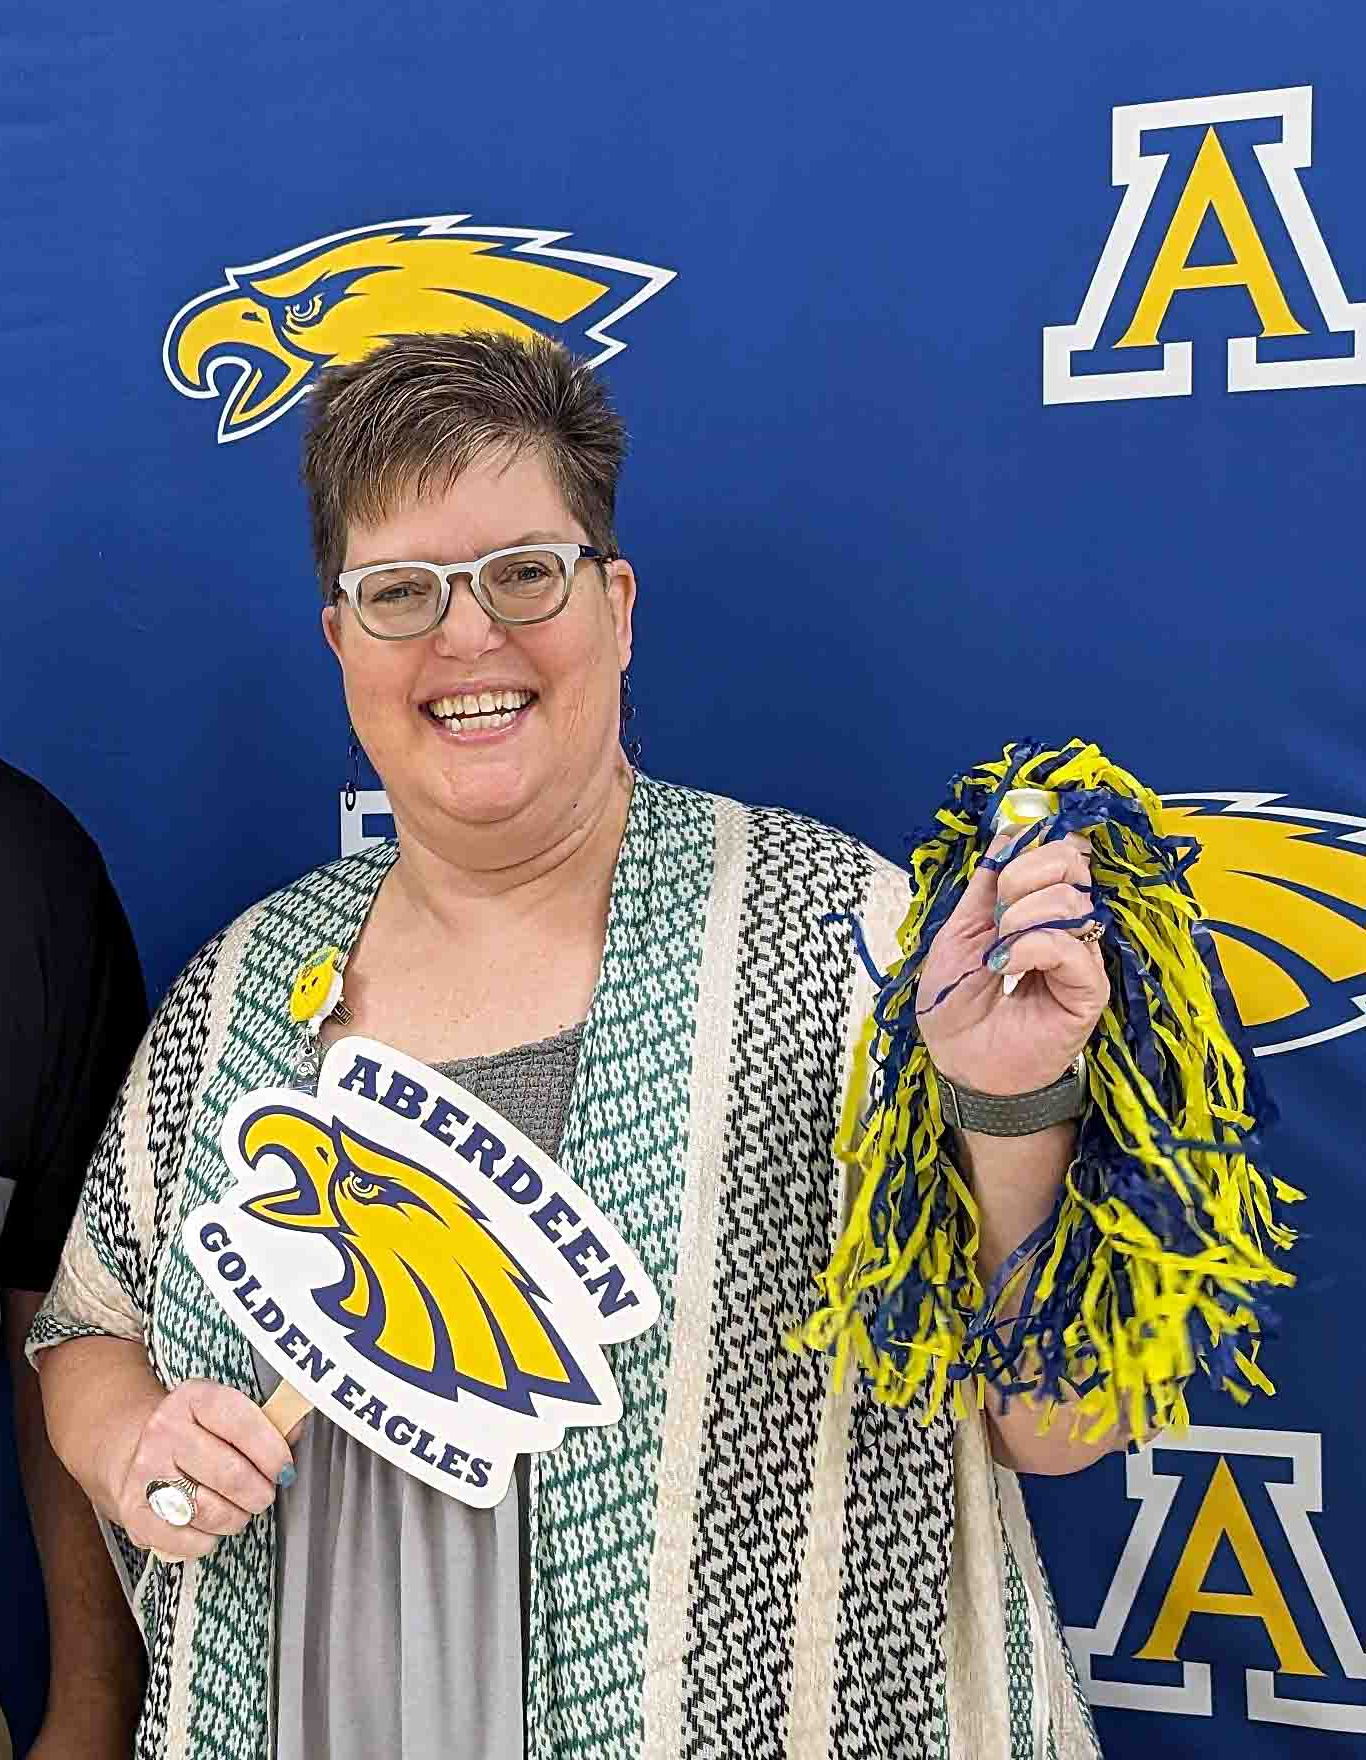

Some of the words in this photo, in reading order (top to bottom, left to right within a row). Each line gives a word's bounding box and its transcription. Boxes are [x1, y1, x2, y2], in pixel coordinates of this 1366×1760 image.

[1043, 85, 1366, 405] A
[338, 1054, 640, 1319] ABERDEEN
[199, 1222, 337, 1383] GOLDEN
[330, 1372, 492, 1488] EAGLES
[1064, 1424, 1366, 1734] A
